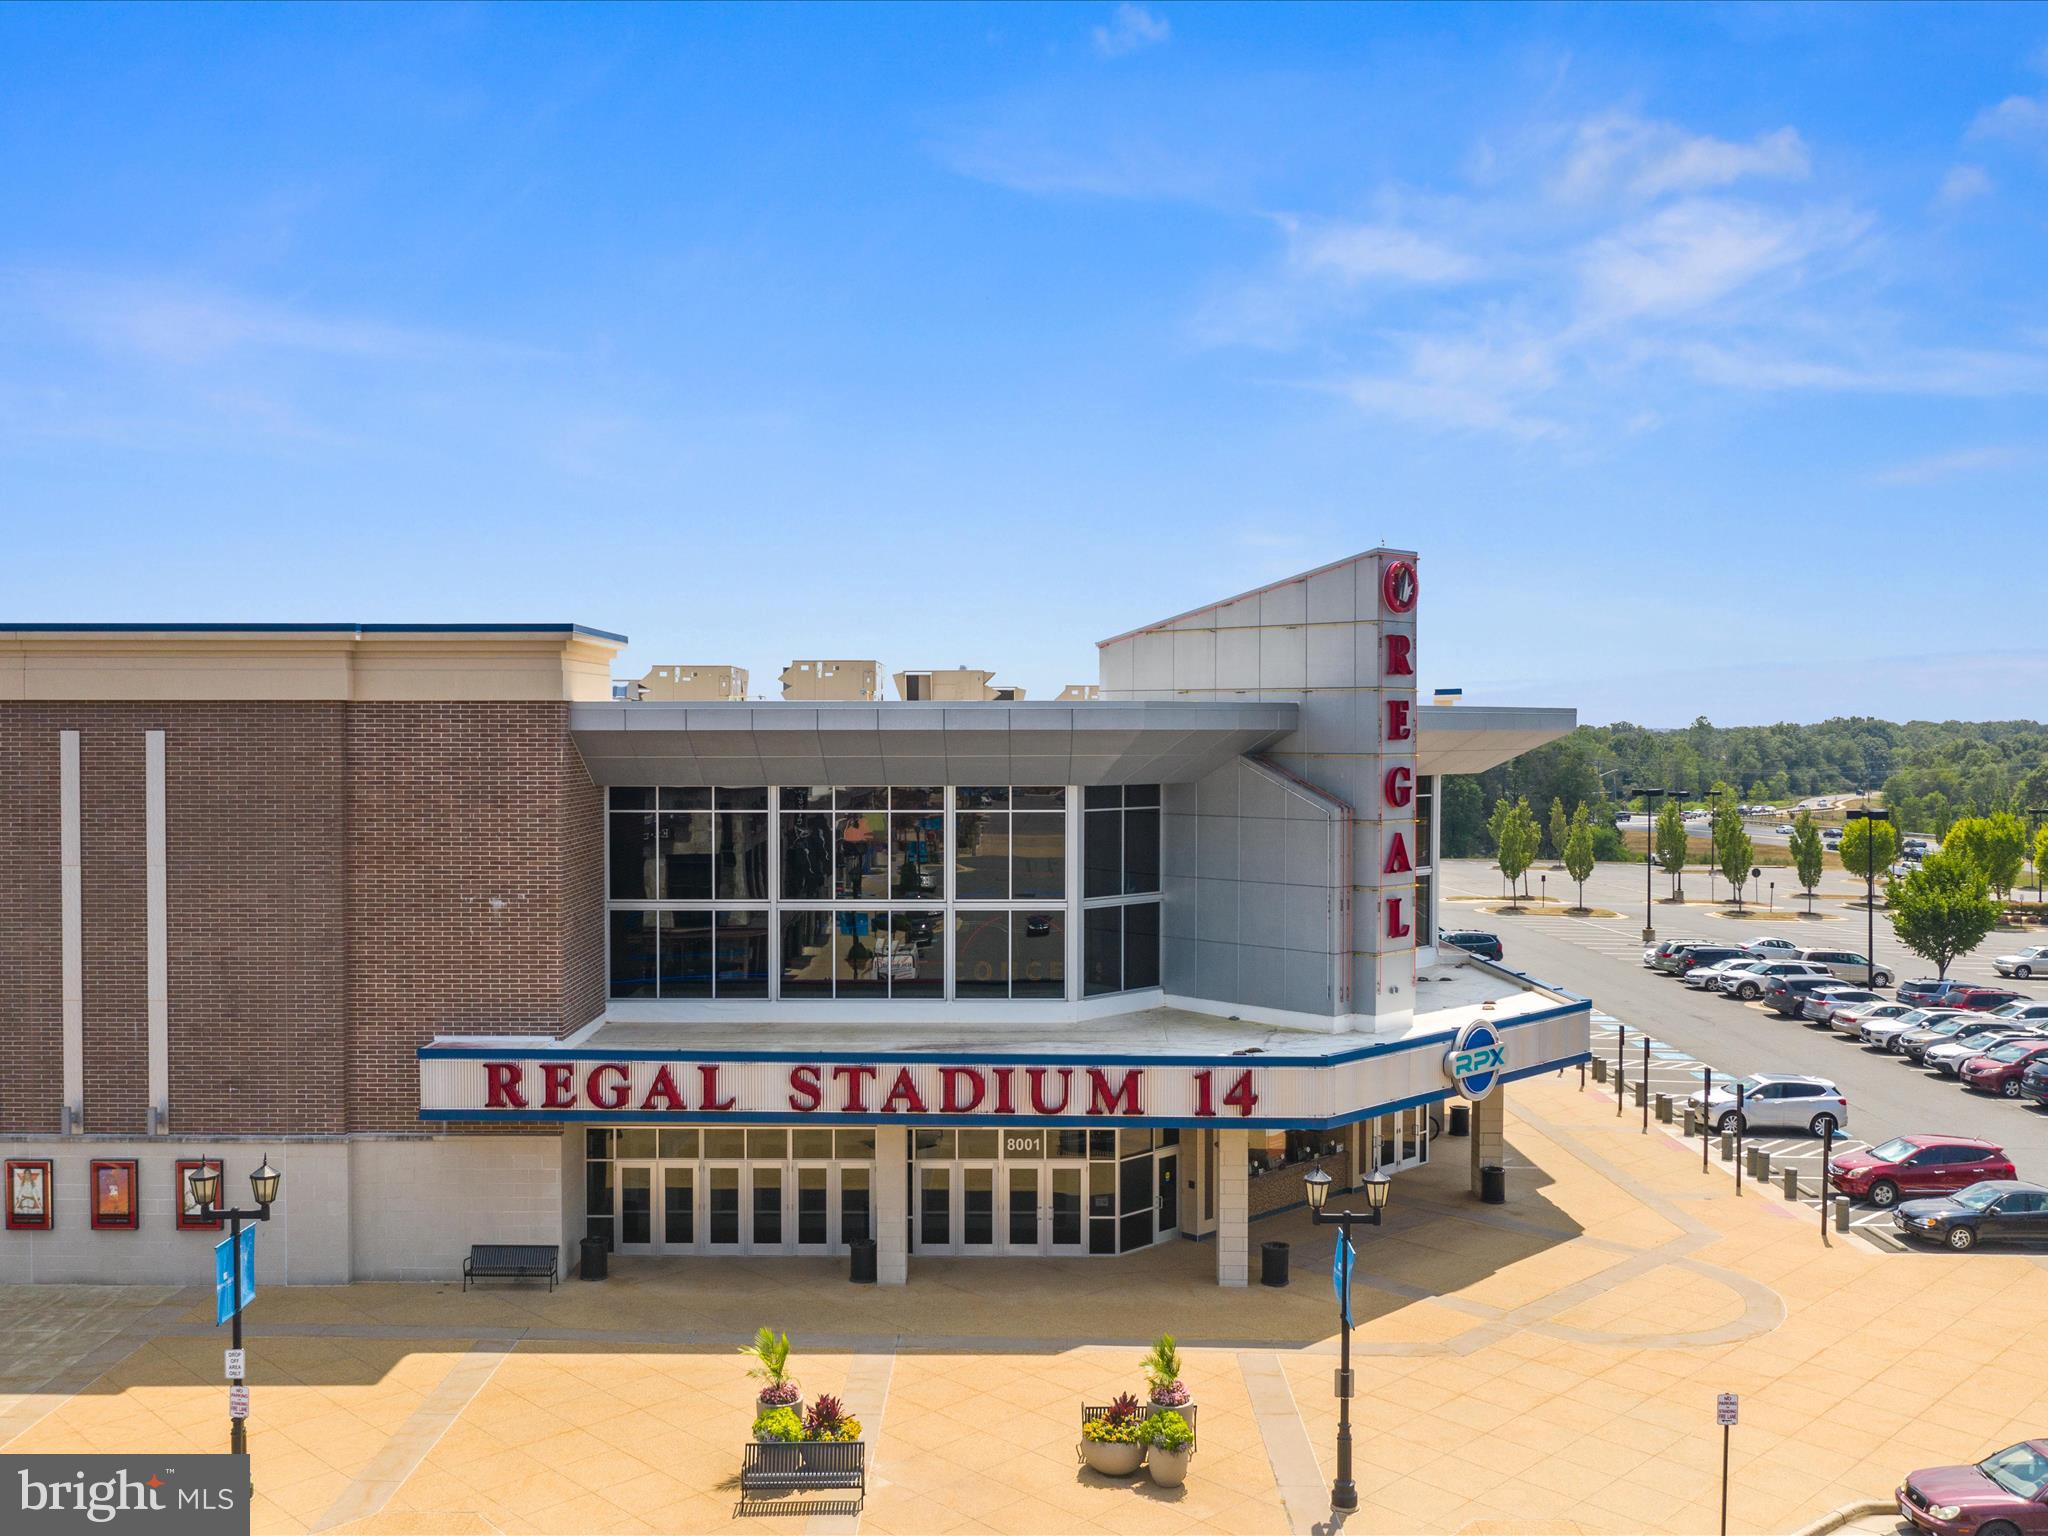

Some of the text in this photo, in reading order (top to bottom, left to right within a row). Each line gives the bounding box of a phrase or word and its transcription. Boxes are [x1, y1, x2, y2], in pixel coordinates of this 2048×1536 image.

[1383, 633, 1414, 939] REGAL
[1455, 1046, 1505, 1076] RPX
[483, 1061, 1260, 1118] REGAL STADIUM 14
[1007, 1138, 1040, 1151] 8001
